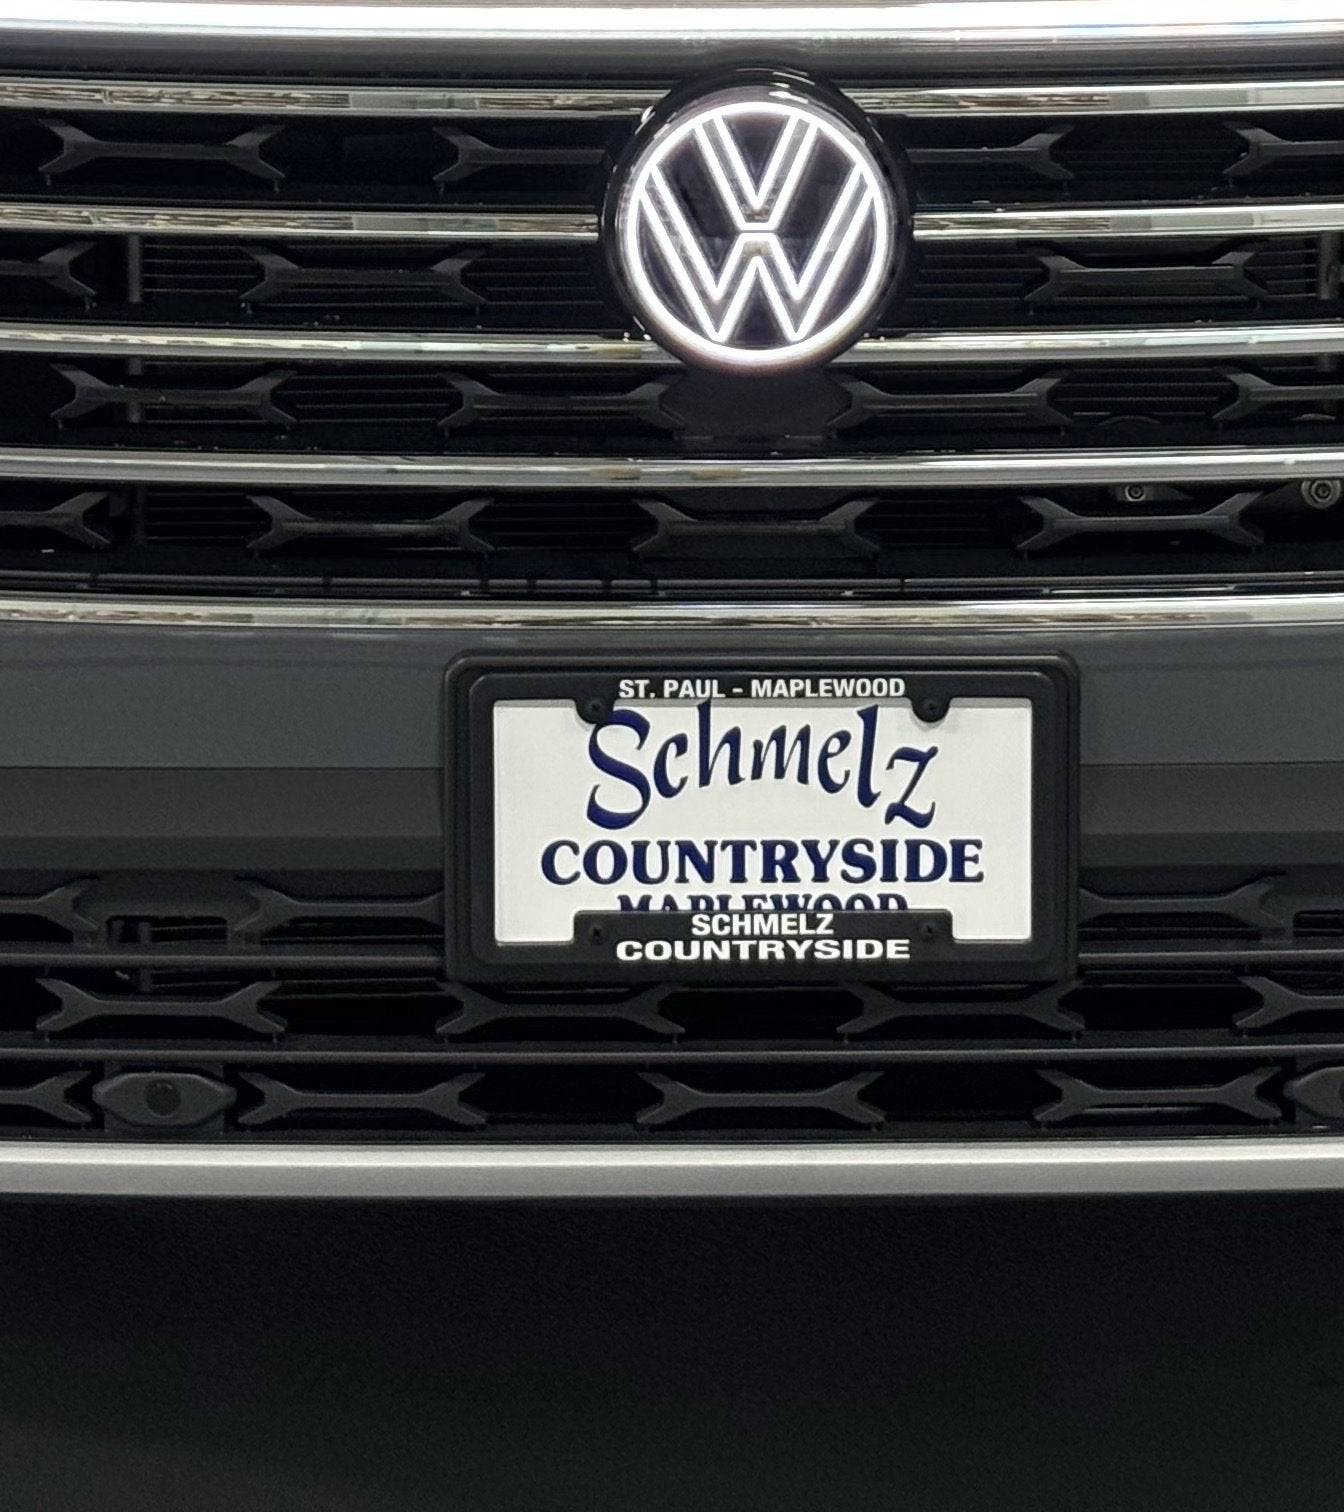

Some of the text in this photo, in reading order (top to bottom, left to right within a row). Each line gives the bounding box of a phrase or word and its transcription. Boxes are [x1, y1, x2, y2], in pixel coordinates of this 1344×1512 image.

[618, 678, 656, 699] ST.
[663, 678, 726, 698] PAUL
[751, 677, 906, 698] MAPLEWOOD
[586, 699, 940, 830] Schmelz
[540, 838, 985, 886] COUNTRYSIDE
[691, 912, 835, 937] SCHMELZ
[616, 939, 911, 961] COUNTRYSIDE
